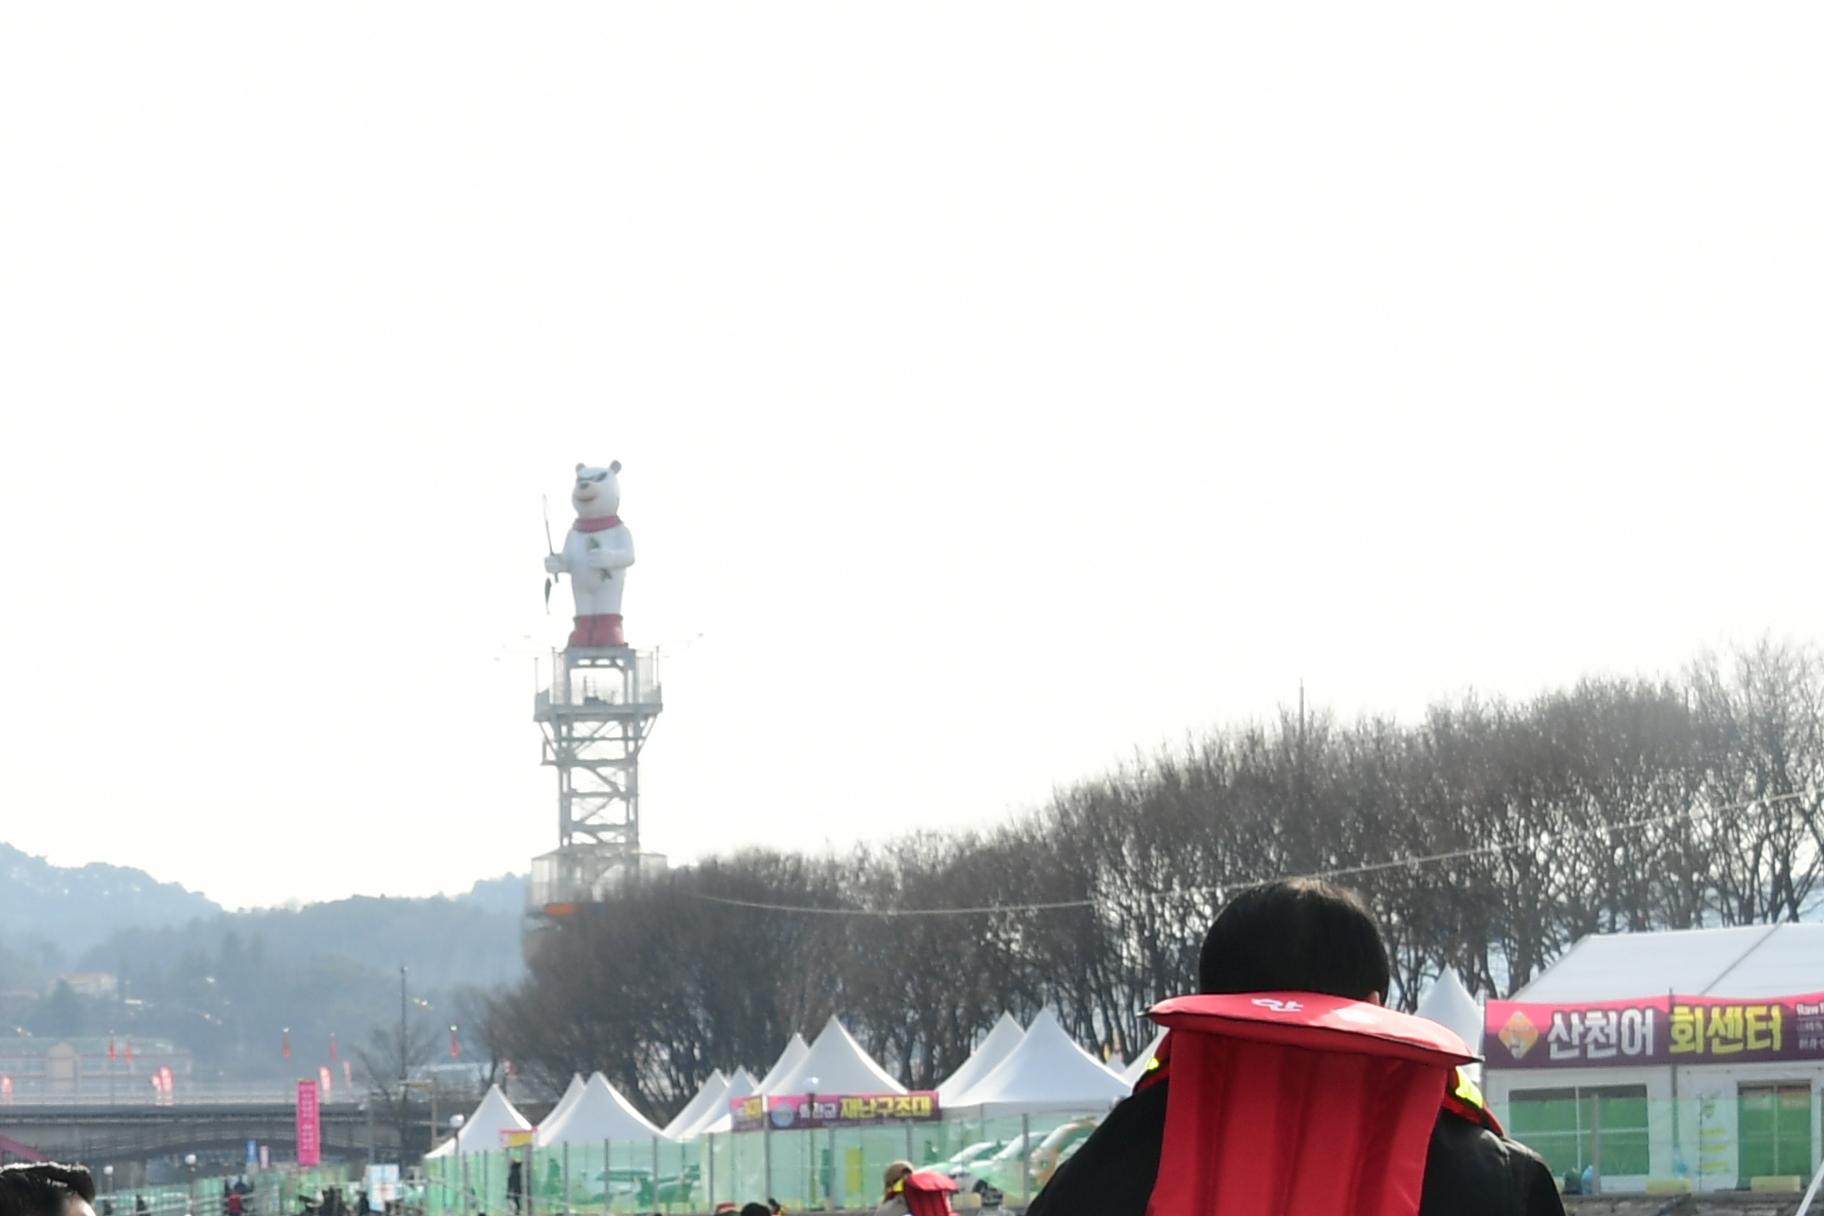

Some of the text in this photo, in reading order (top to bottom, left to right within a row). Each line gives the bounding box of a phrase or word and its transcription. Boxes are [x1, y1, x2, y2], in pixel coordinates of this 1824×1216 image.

[1547, 1003, 1783, 1060] 산천어 회센터
[840, 1095, 931, 1120] 재난구조대
